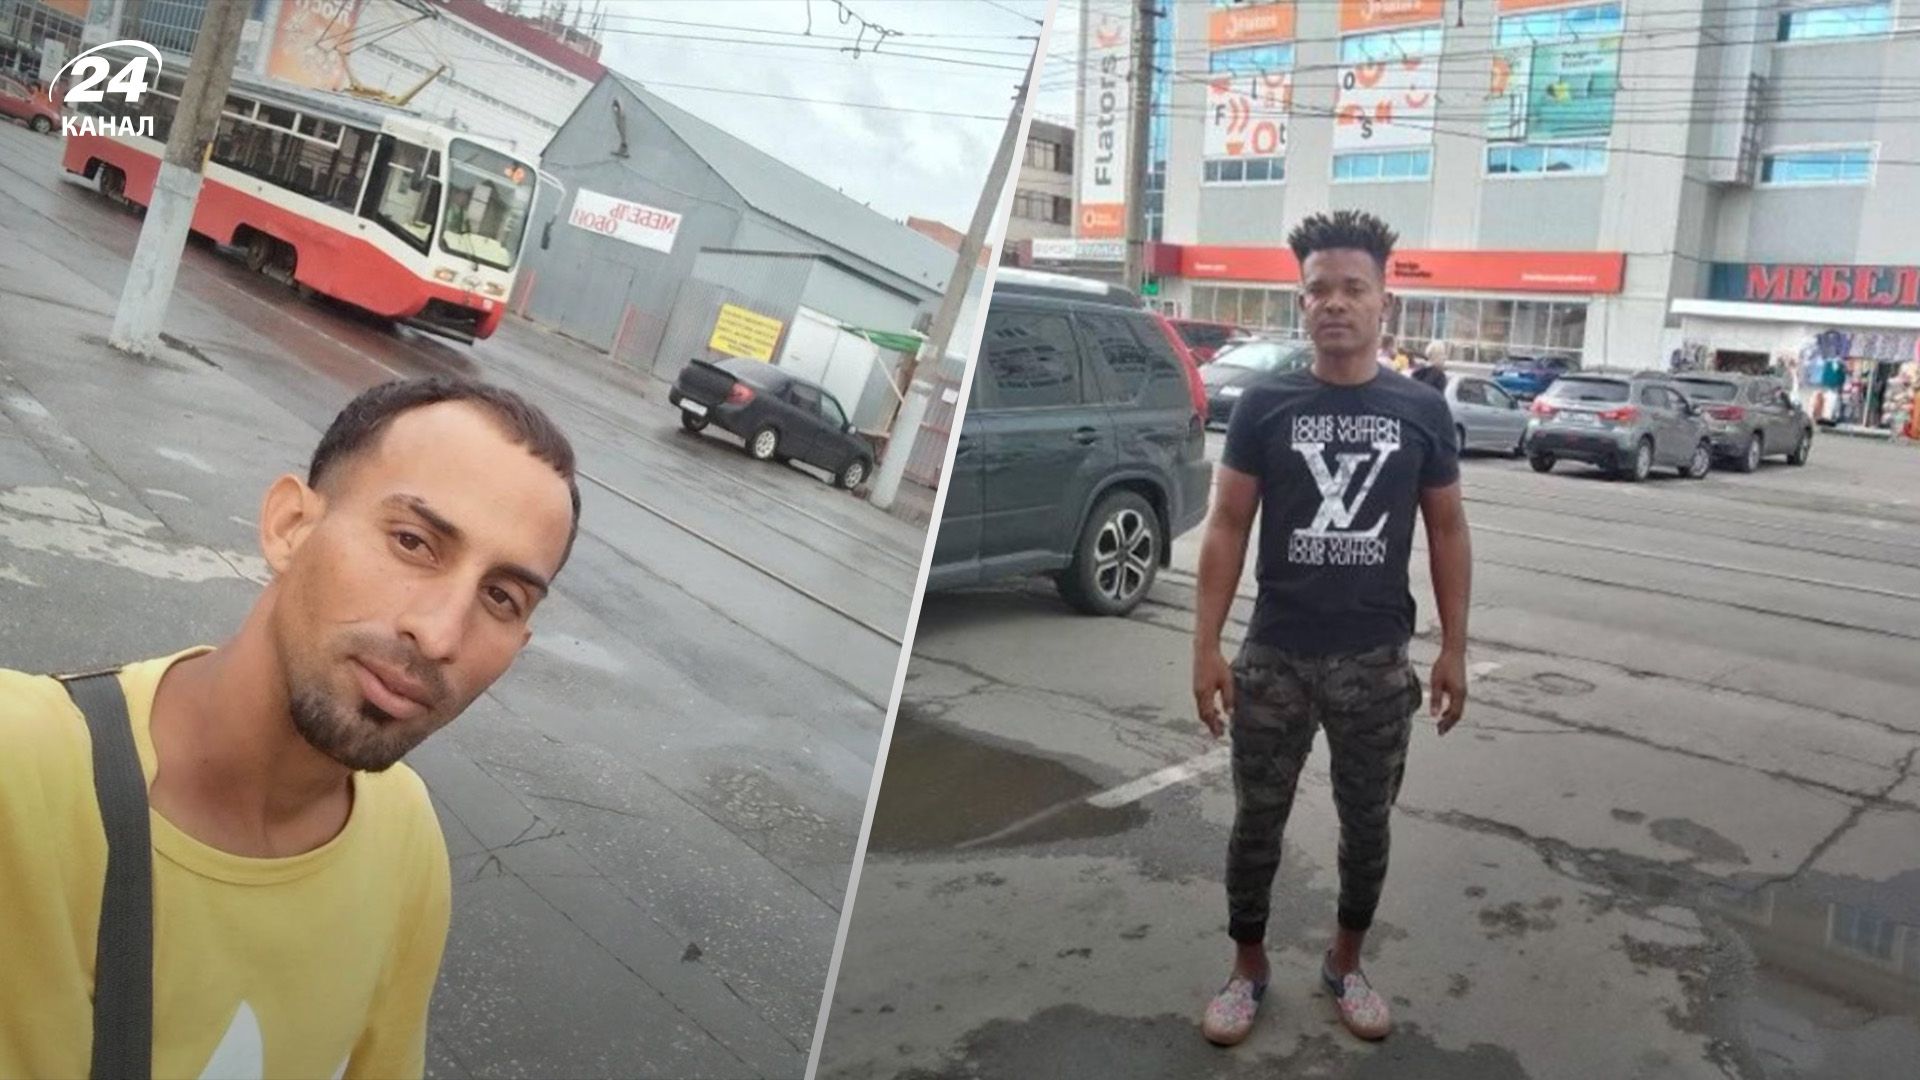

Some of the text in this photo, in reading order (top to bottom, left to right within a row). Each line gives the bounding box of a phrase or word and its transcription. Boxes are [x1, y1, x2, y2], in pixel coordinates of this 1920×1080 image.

[1095, 54, 1117, 187] Flators
[1292, 414, 1400, 431] LOUIS VUITTON
[1292, 428, 1400, 443] LOUIS VUITTON
[1289, 537, 1387, 553] LOUIS VUITTON
[1288, 550, 1385, 566] LOUIS VUITTON
